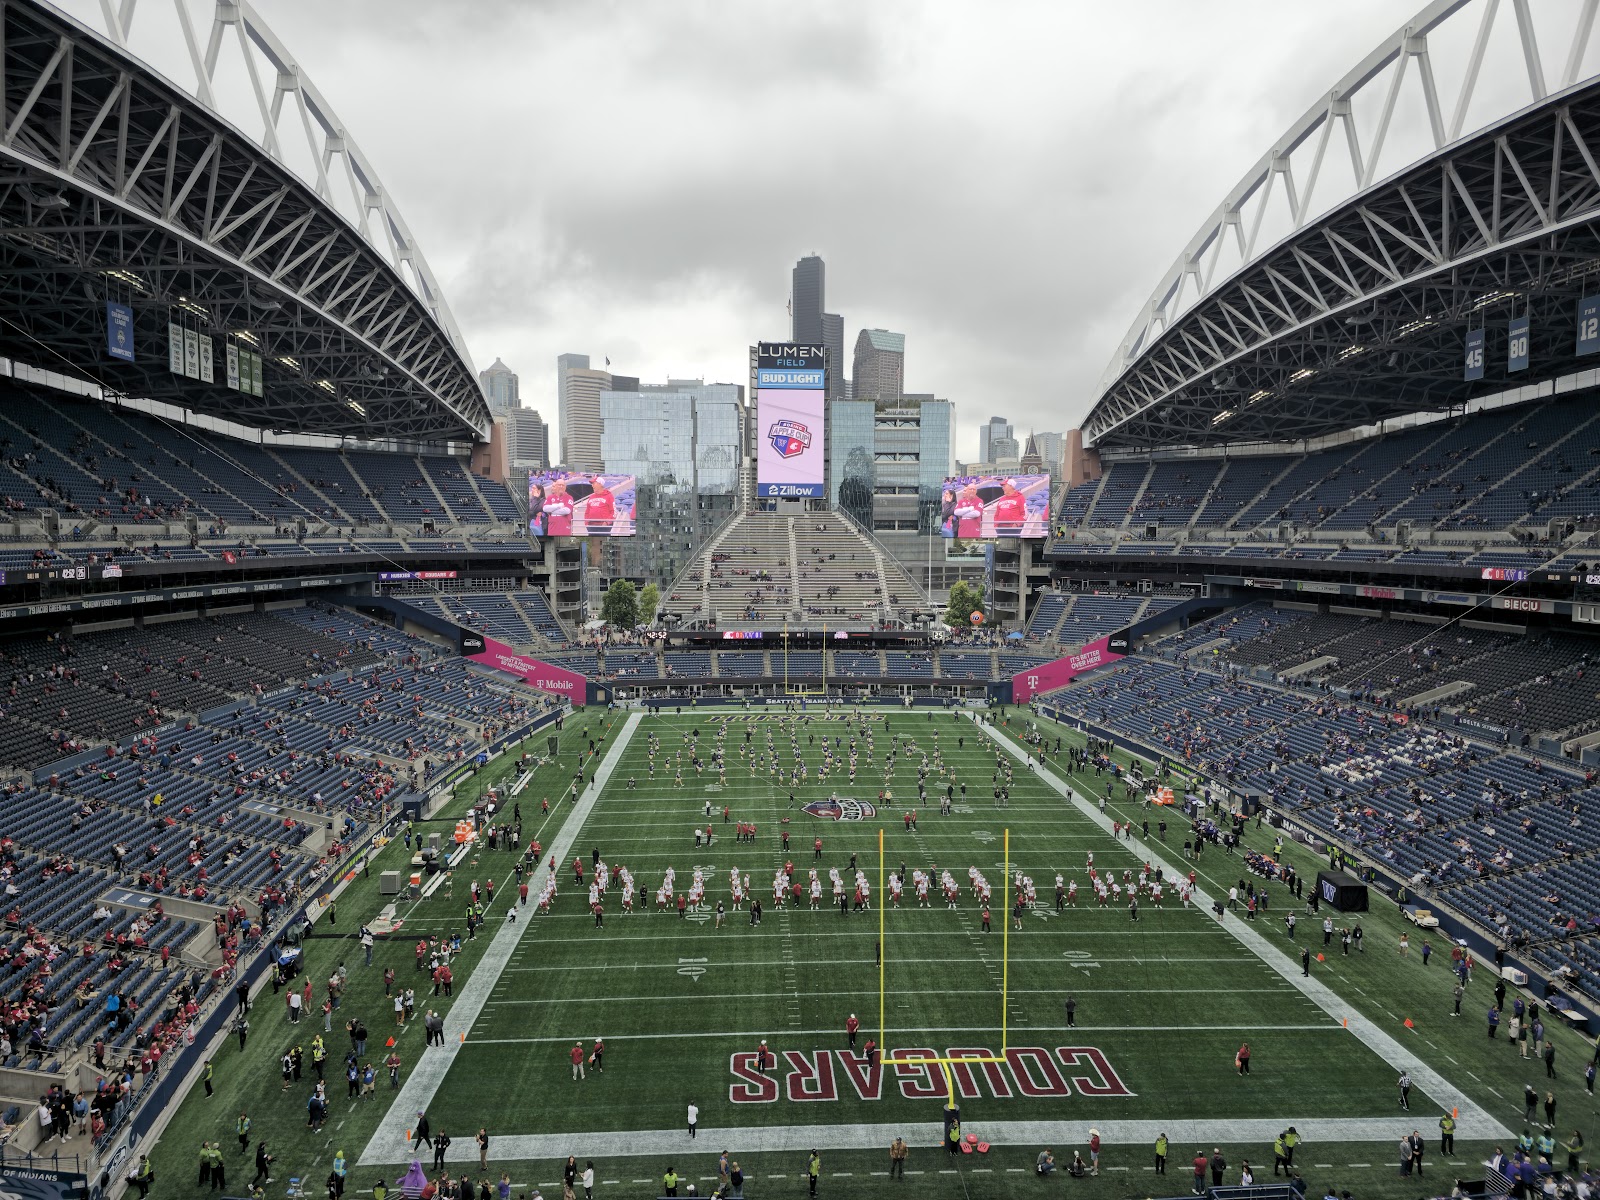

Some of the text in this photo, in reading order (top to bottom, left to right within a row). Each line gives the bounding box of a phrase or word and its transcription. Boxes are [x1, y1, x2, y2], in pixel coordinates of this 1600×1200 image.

[1580, 317, 1598, 341] 12
[759, 346, 823, 358] LUMEN
[1510, 337, 1527, 359] 80
[776, 359, 806, 367] FIELD
[1466, 348, 1482, 369] 45
[762, 374, 820, 384] BUD LIGHT
[773, 427, 808, 442] APPLE CUP
[780, 485, 812, 496] Zillow
[646, 631, 667, 639] 42:52
[1070, 650, 1100, 664] IT'S BETTER
[1071, 660, 1087, 670] OVER
[1086, 656, 1101, 665] HERE
[546, 680, 573, 689] Mobile
[1463, 718, 1481, 728] DELTA
[1321, 880, 1336, 903] W
[729, 1047, 1138, 1104] COUGARS
[3, 1169, 58, 1182] OF INDIANS
